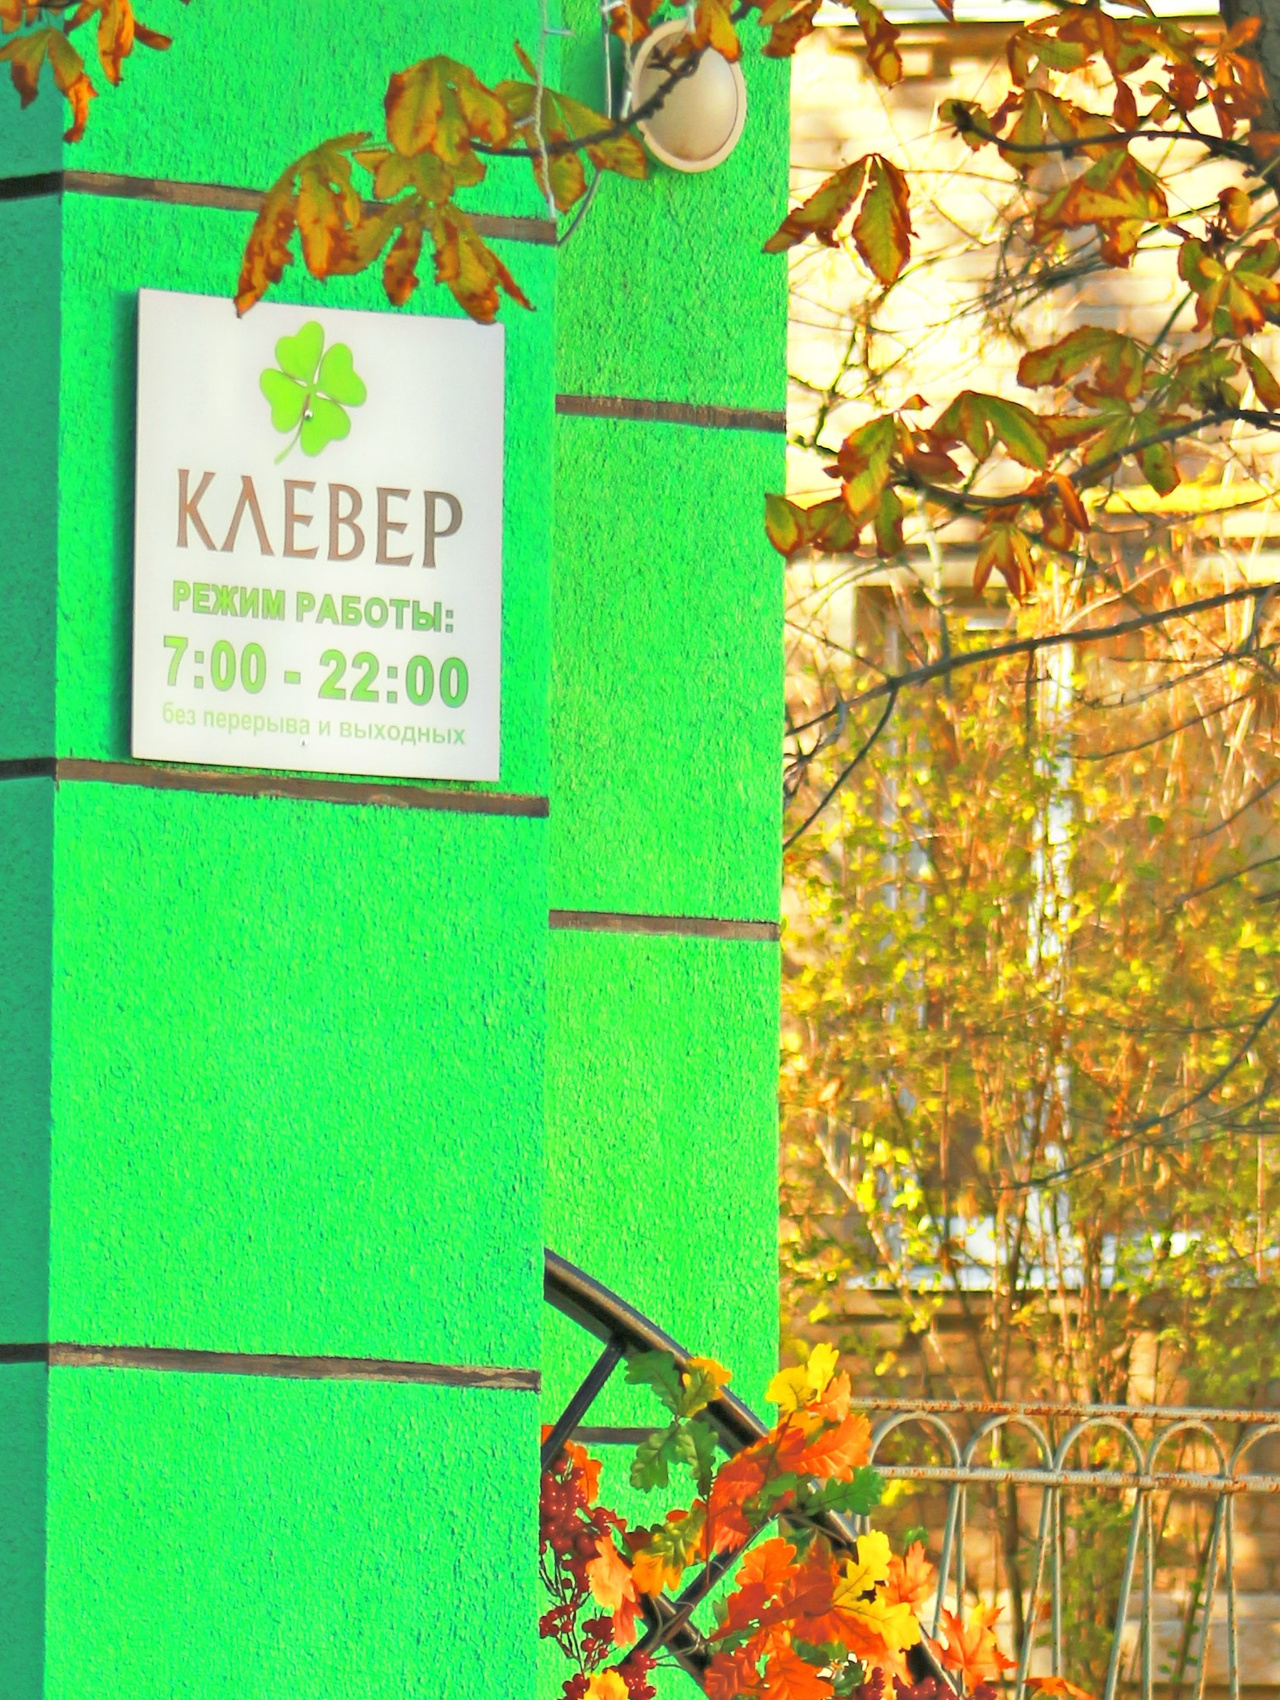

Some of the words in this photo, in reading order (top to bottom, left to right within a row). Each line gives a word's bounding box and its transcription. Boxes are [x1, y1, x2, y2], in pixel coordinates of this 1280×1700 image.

[176, 468, 464, 569] КЛЕВЕР
[172, 580, 285, 621] РЕЖИМ
[295, 592, 455, 633] РАБОТЫ:
[163, 635, 267, 694] 7:00
[317, 648, 469, 708] 22:00
[162, 702, 196, 726] без
[203, 710, 310, 737] перерыва
[318, 719, 331, 736] и
[339, 721, 466, 746] выходных
